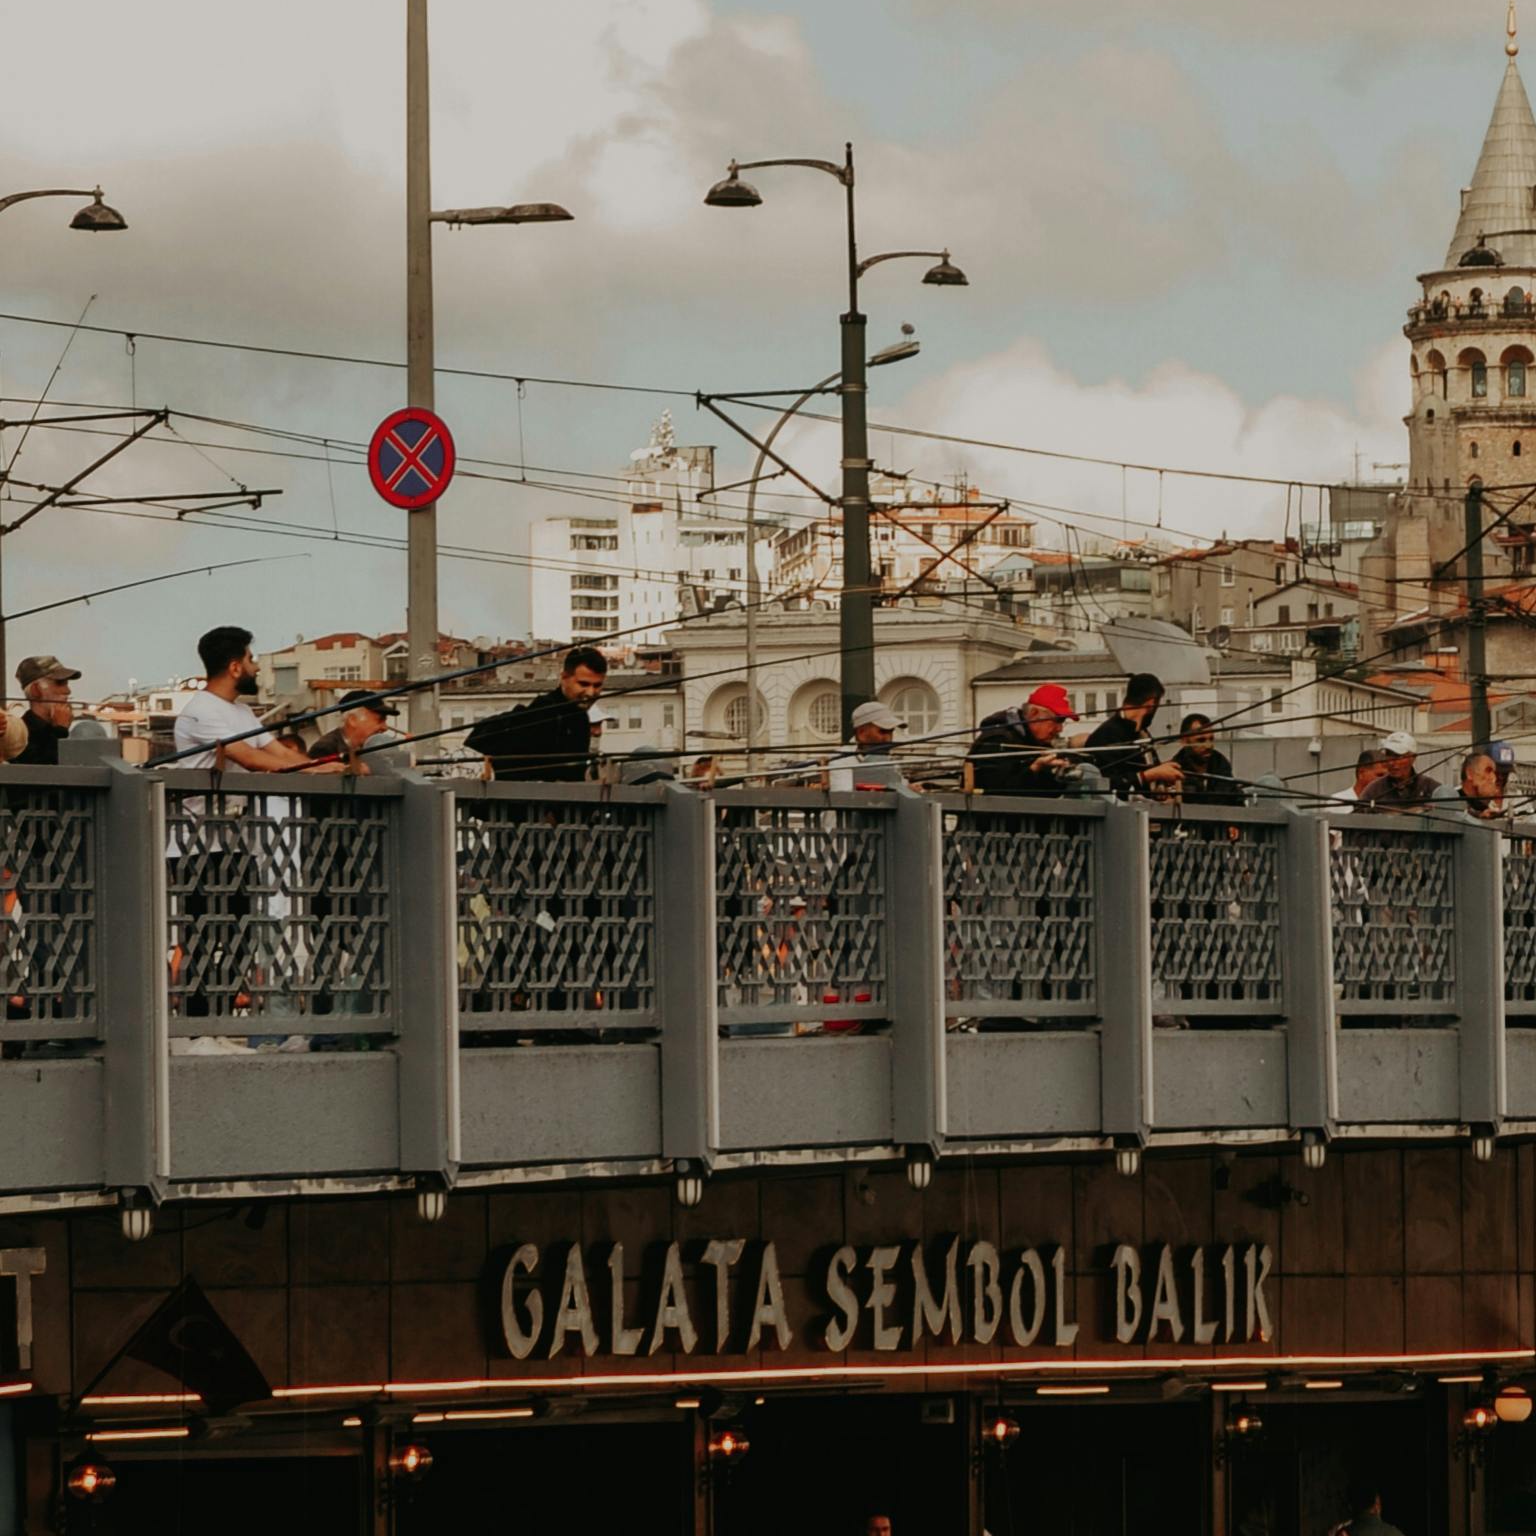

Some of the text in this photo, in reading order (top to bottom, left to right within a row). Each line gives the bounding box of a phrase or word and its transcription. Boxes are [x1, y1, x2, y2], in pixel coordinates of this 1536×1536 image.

[501, 1234, 1274, 1361] GALATA SEMBOL BALIK
